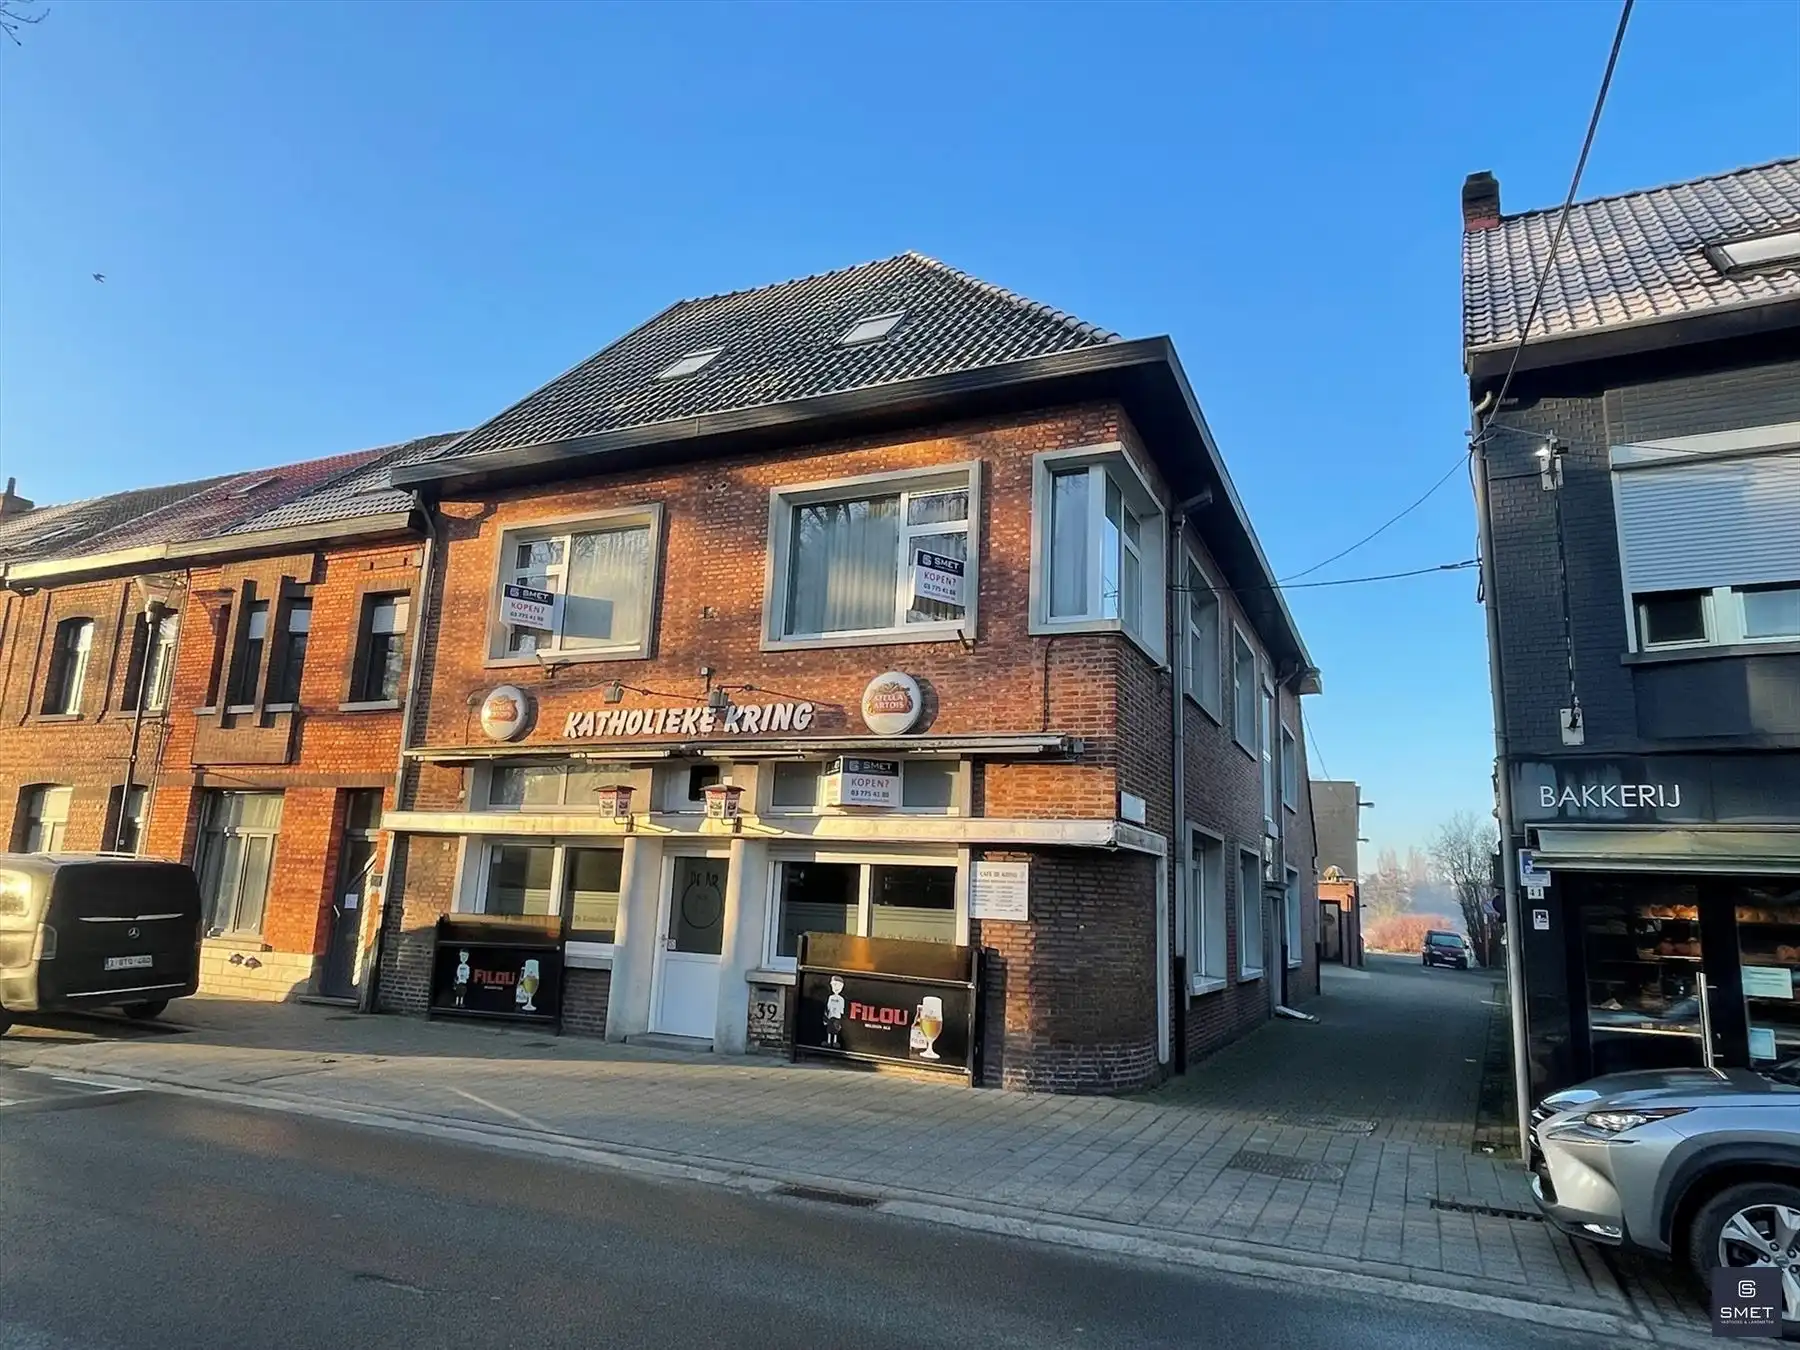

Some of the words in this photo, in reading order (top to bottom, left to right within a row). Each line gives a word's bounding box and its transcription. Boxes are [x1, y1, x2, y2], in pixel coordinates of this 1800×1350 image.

[934, 557, 960, 570] SMET
[924, 571, 957, 586] KOPEN?
[522, 589, 549, 600] SMET
[511, 602, 545, 614] KOPEN?
[874, 693, 905, 702] STELLA
[874, 701, 905, 709] ARTOIS
[563, 708, 717, 739] KATHOLIEKE
[724, 703, 814, 735] KRING
[863, 760, 893, 770] SMET
[851, 778, 890, 788] KOPEN?
[850, 789, 859, 797] 03
[1540, 784, 1680, 808] BAKKERIJ
[1529, 888, 1542, 898] 41
[473, 968, 516, 986] FILOU
[755, 1002, 777, 1021] 39
[849, 1001, 908, 1026] FILOU
